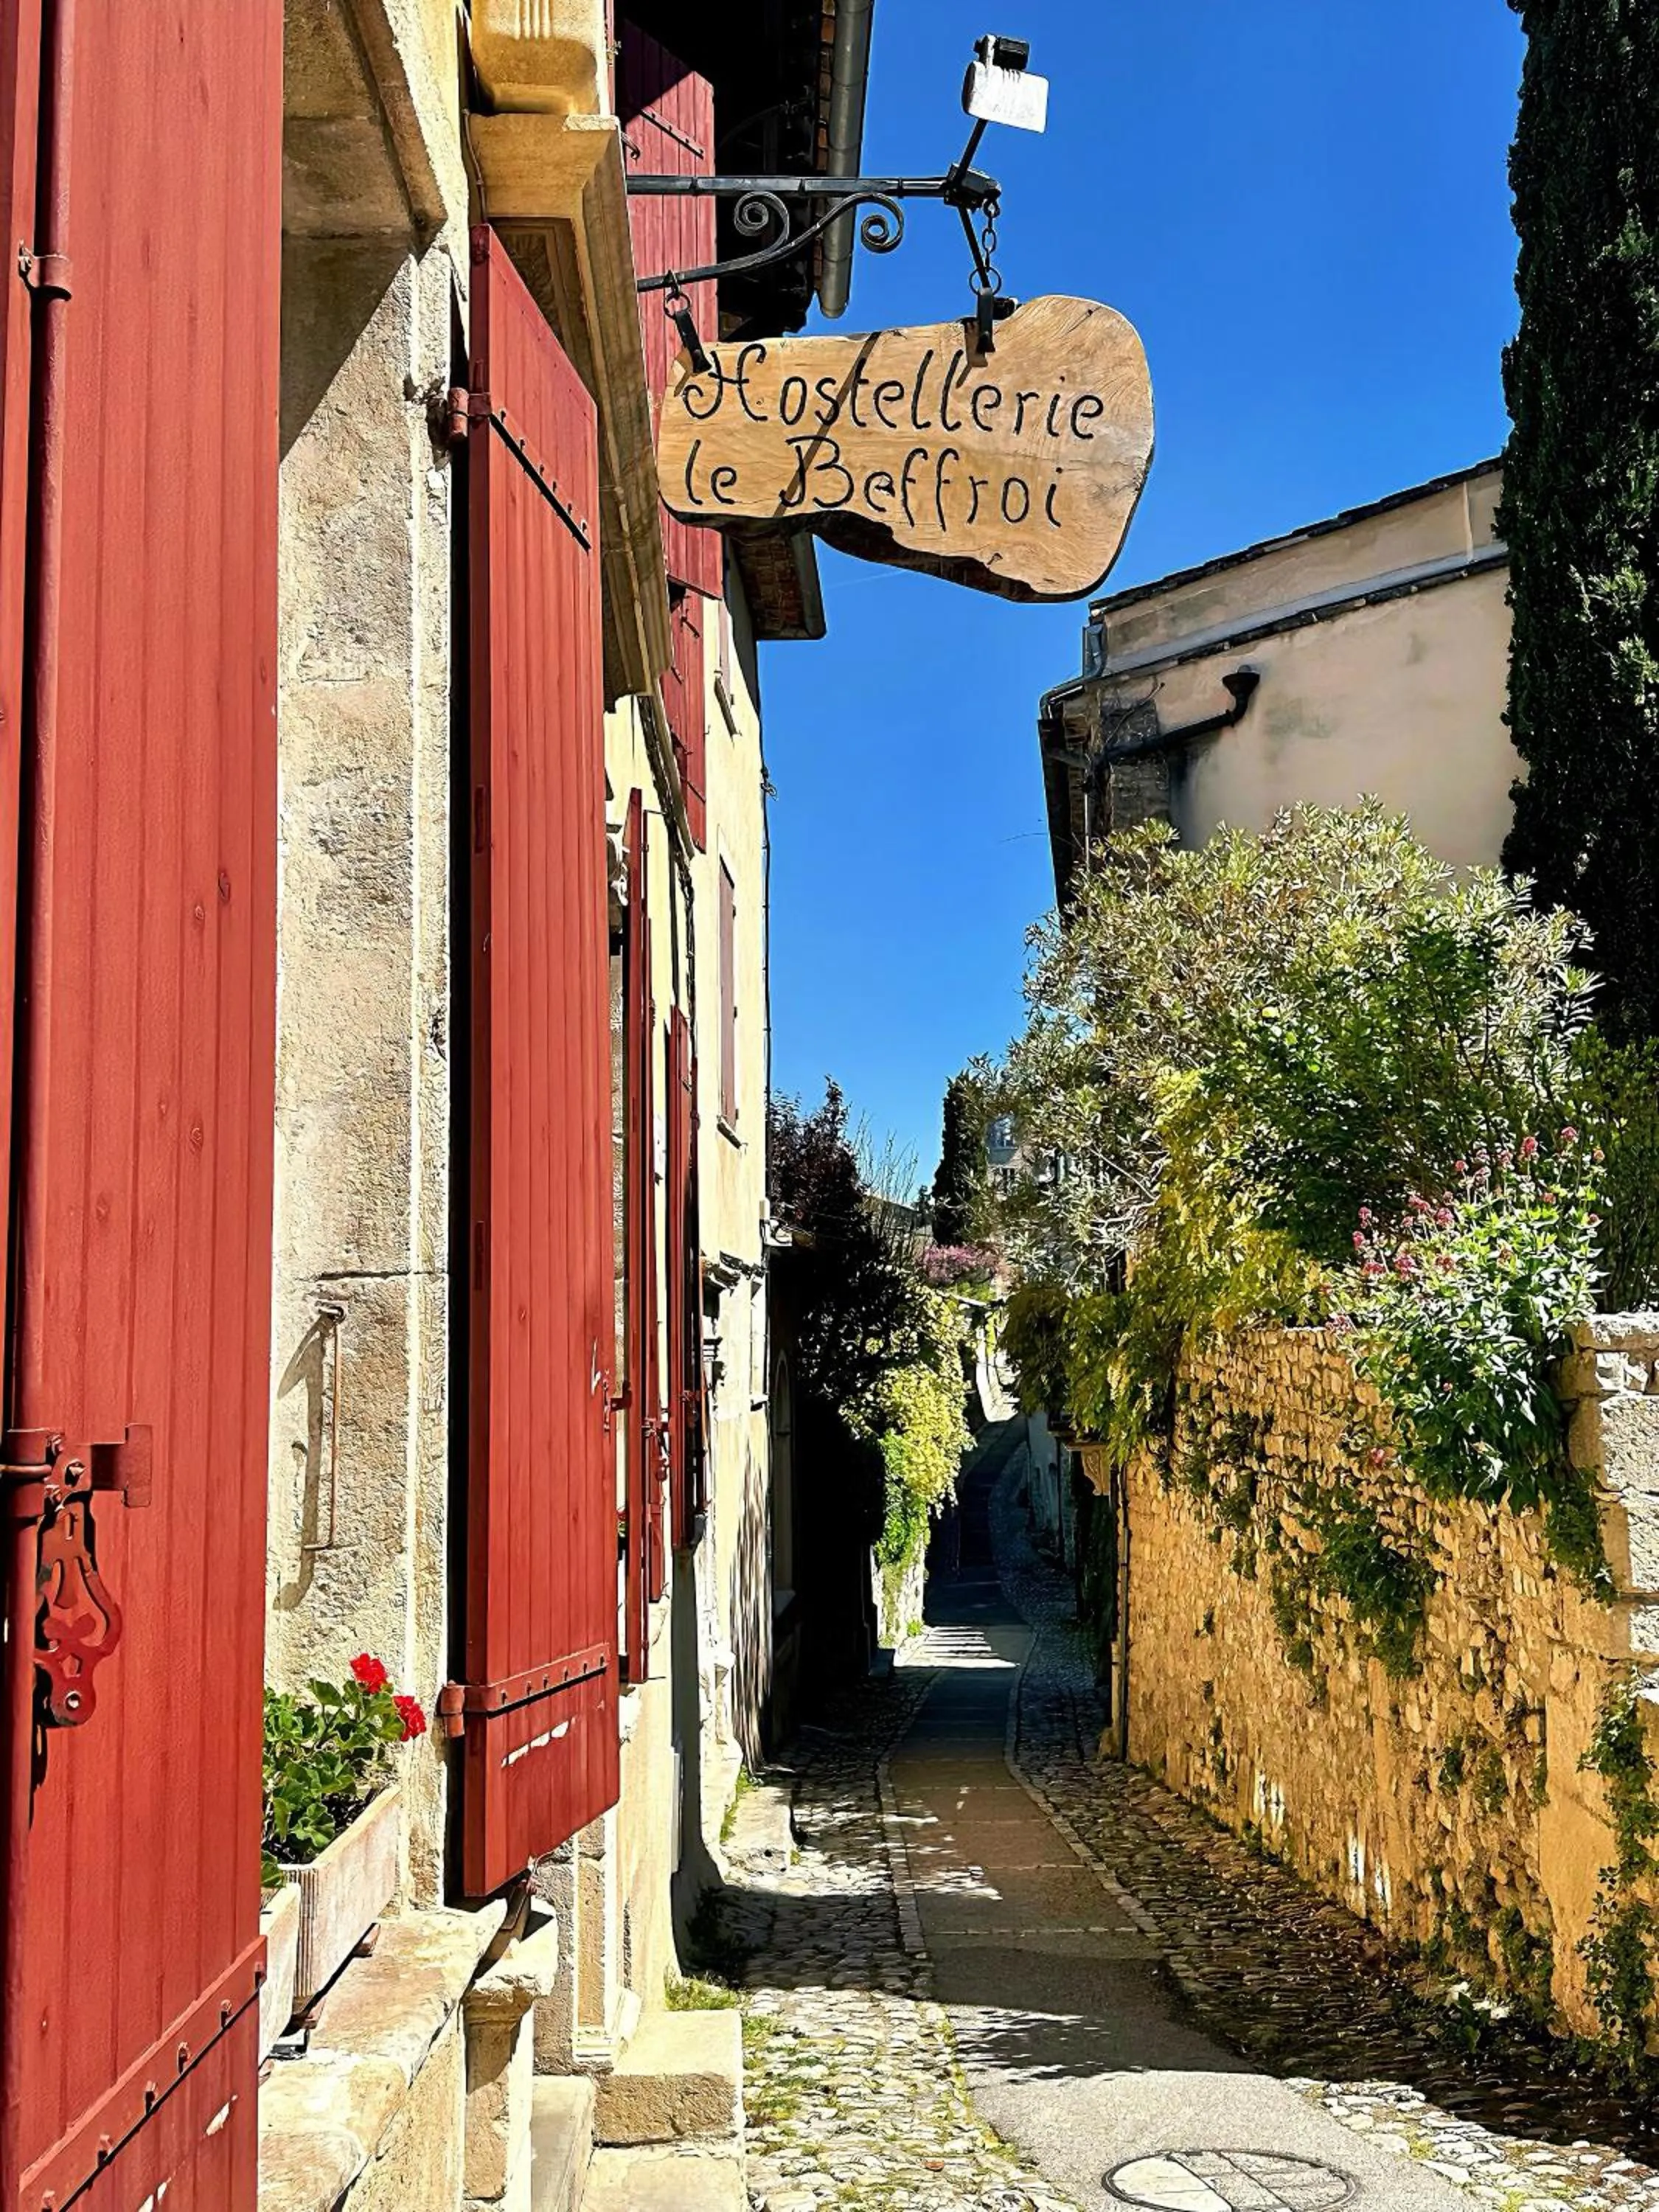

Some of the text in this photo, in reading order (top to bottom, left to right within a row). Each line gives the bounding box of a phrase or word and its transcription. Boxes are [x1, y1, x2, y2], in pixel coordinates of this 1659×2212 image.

[682, 344, 1105, 440] Hostellerie
[684, 435, 1062, 532] le Beffroi
